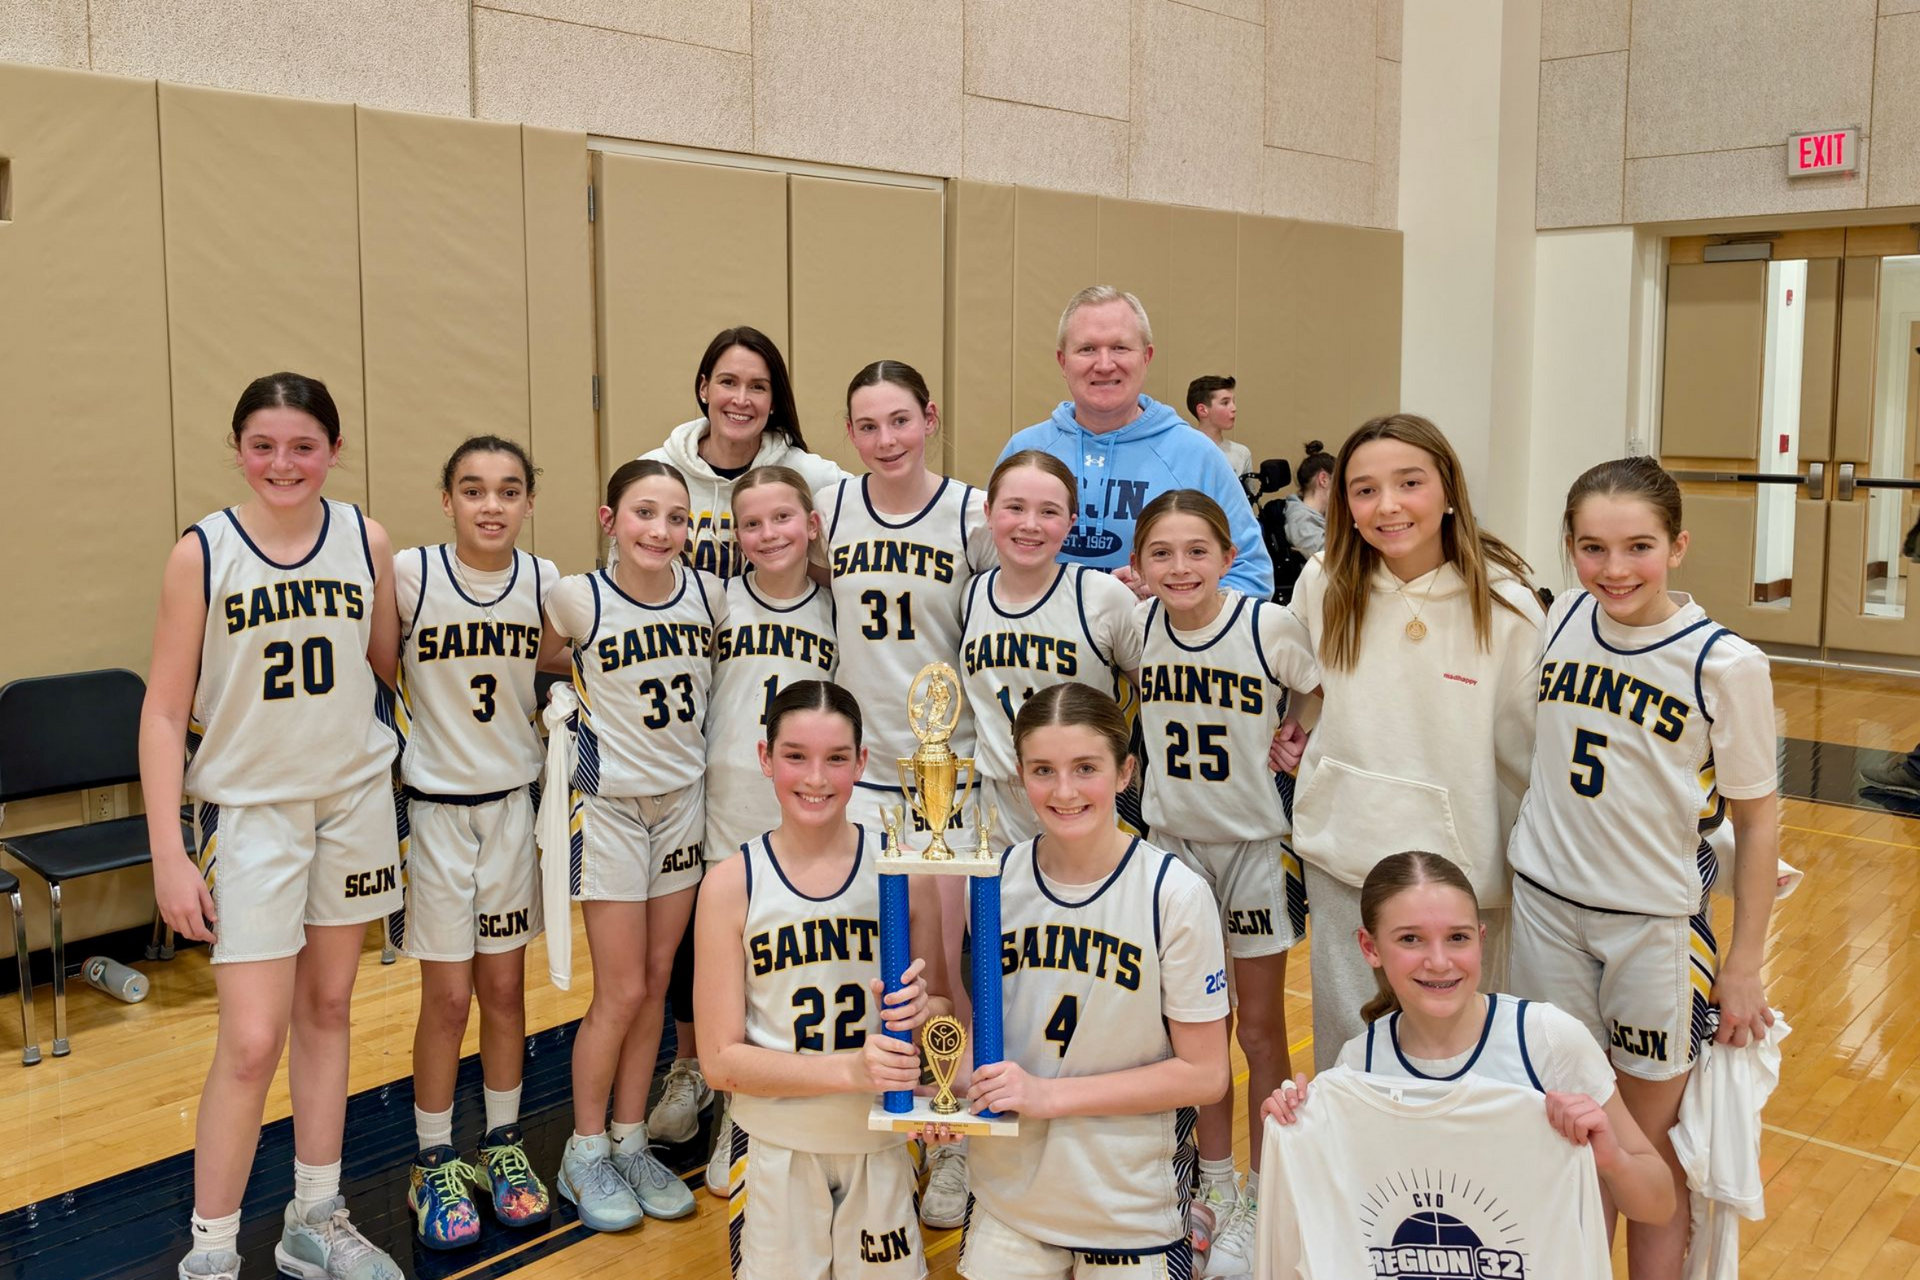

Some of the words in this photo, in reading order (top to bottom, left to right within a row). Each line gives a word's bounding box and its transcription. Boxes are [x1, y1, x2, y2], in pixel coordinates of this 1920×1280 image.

[1799, 133, 1846, 169] EXIT
[832, 539, 955, 585] SAINTS
[1062, 534, 1082, 548] ST.
[1086, 535, 1114, 550] 1967
[224, 579, 364, 634] SAINTS
[860, 589, 916, 641] 31
[417, 621, 540, 663] SAINTS
[598, 623, 712, 673] SAINTS
[717, 622, 834, 672] SAINTS
[965, 632, 1077, 677] SAINTS
[263, 636, 335, 700] 20
[1141, 663, 1263, 716] SAINTS
[1443, 673, 1478, 686] madhappy
[470, 673, 498, 723] 3
[638, 672, 697, 731] 33
[996, 685, 1035, 736] 1
[1538, 660, 1690, 743] SAINTS
[1165, 719, 1231, 782] 25
[1570, 727, 1608, 799] 5
[912, 806, 964, 832] SN
[344, 864, 397, 898] SCJN
[478, 908, 530, 938] SCJN
[750, 917, 879, 976] SAINT
[1002, 925, 1143, 992] SAINTS
[792, 983, 867, 1052] 22
[1043, 993, 1079, 1058] 4
[1412, 1193, 1445, 1209] CYO
[1370, 1247, 1473, 1277] REGION
[1477, 1250, 1524, 1280] 32
